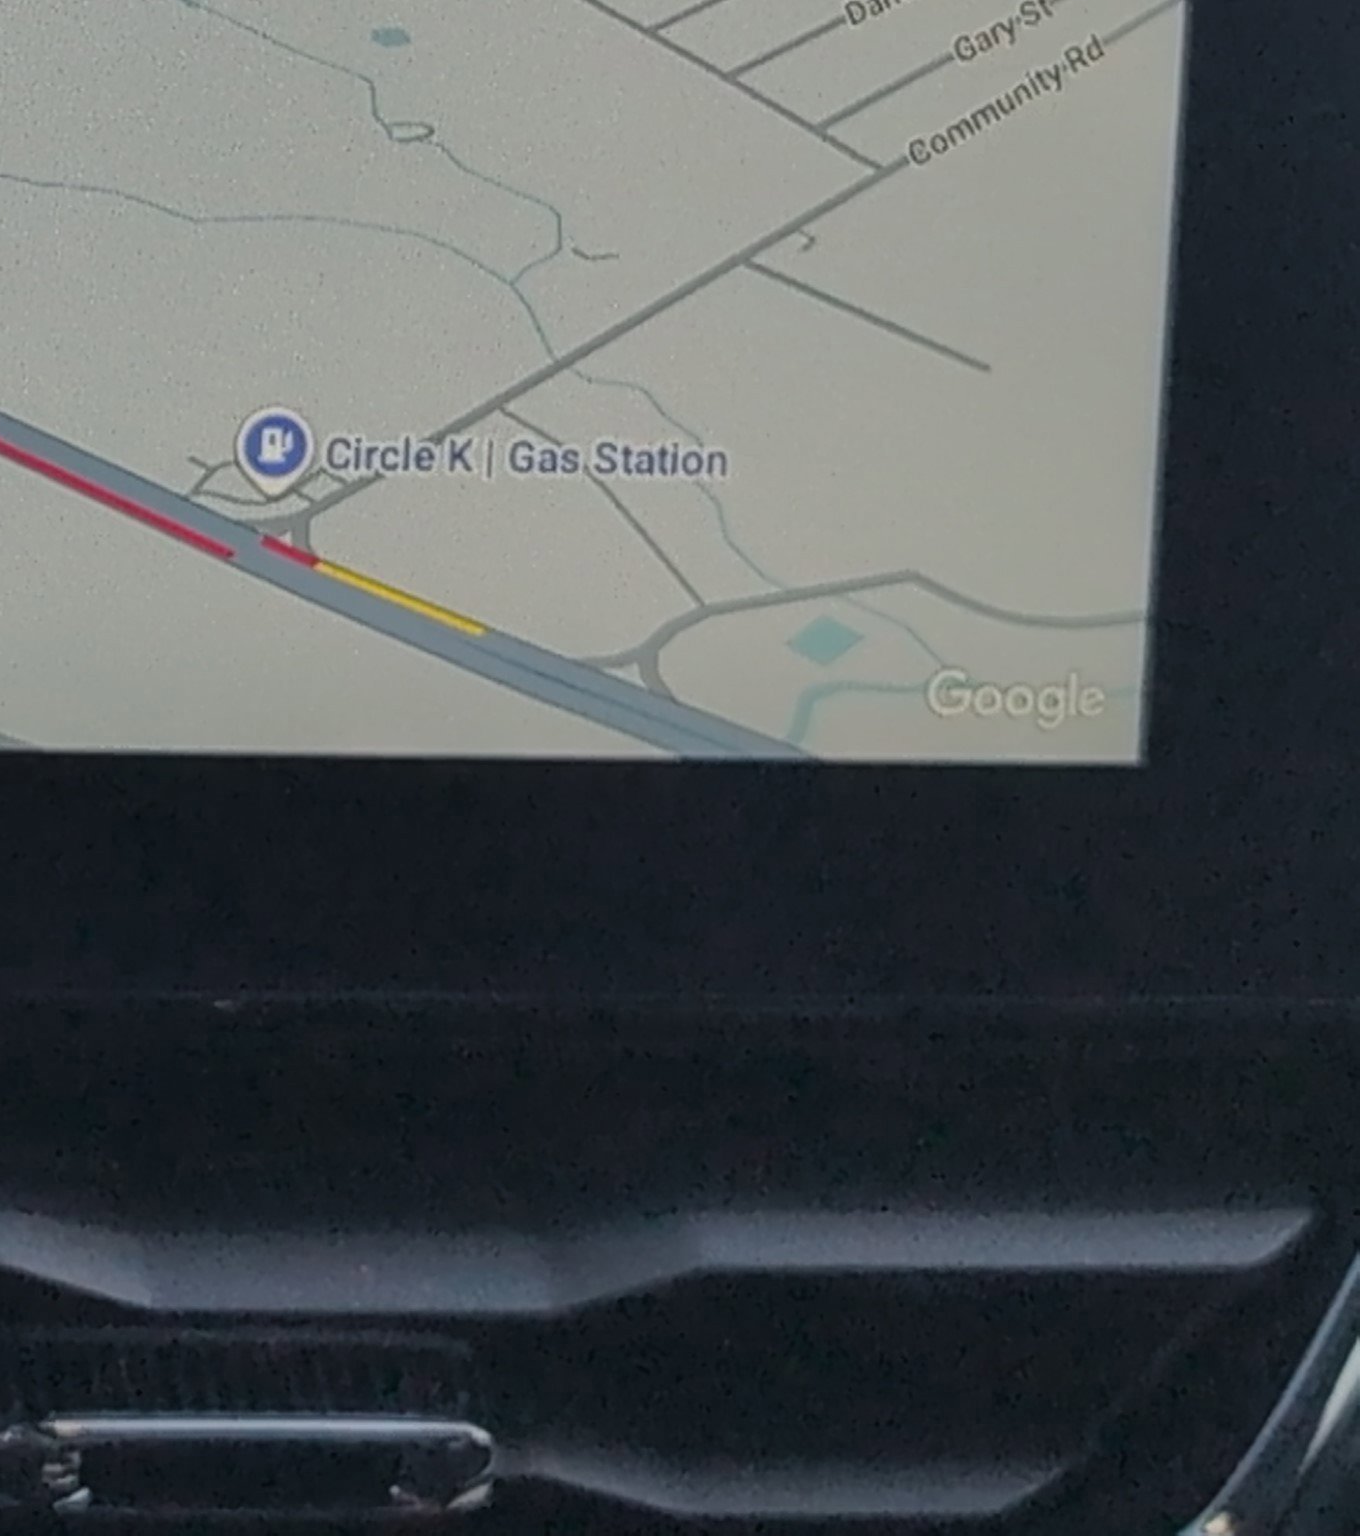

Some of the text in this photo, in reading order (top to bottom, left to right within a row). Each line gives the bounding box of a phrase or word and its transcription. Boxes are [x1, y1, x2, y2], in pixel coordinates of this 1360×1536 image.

[952, 10, 1021, 66] Gary
[906, 30, 1109, 168] Community Rd
[324, 437, 437, 475] Circle
[446, 438, 474, 473] K
[508, 441, 580, 474] Gas
[594, 439, 729, 477] Station
[926, 667, 1106, 731] Google
